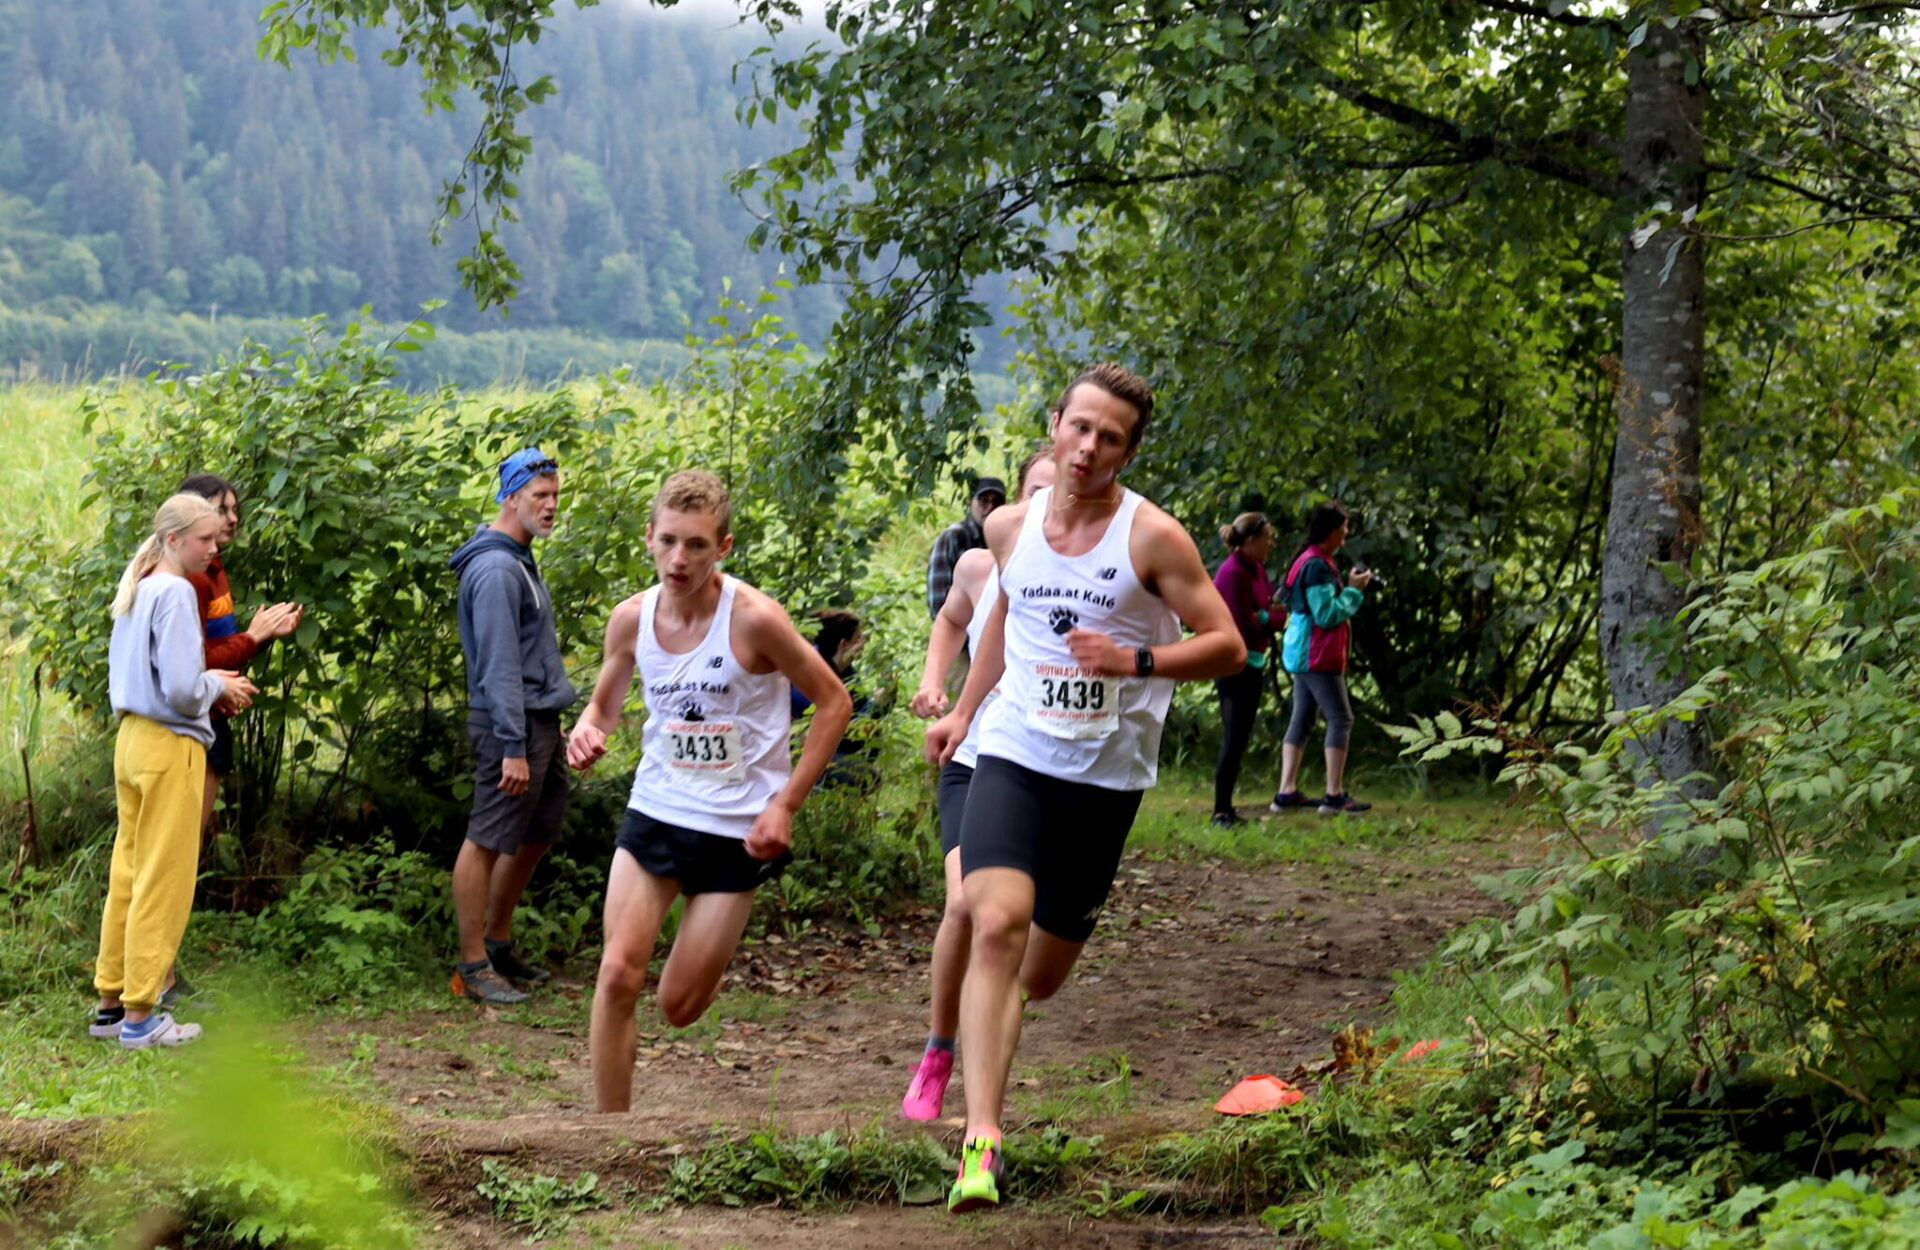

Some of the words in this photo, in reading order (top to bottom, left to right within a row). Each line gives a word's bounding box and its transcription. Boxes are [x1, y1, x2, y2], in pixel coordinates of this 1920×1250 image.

[1021, 585, 1079, 599] Yadaa.at
[1042, 679, 1104, 710] 3439
[672, 734, 728, 762] 3433
